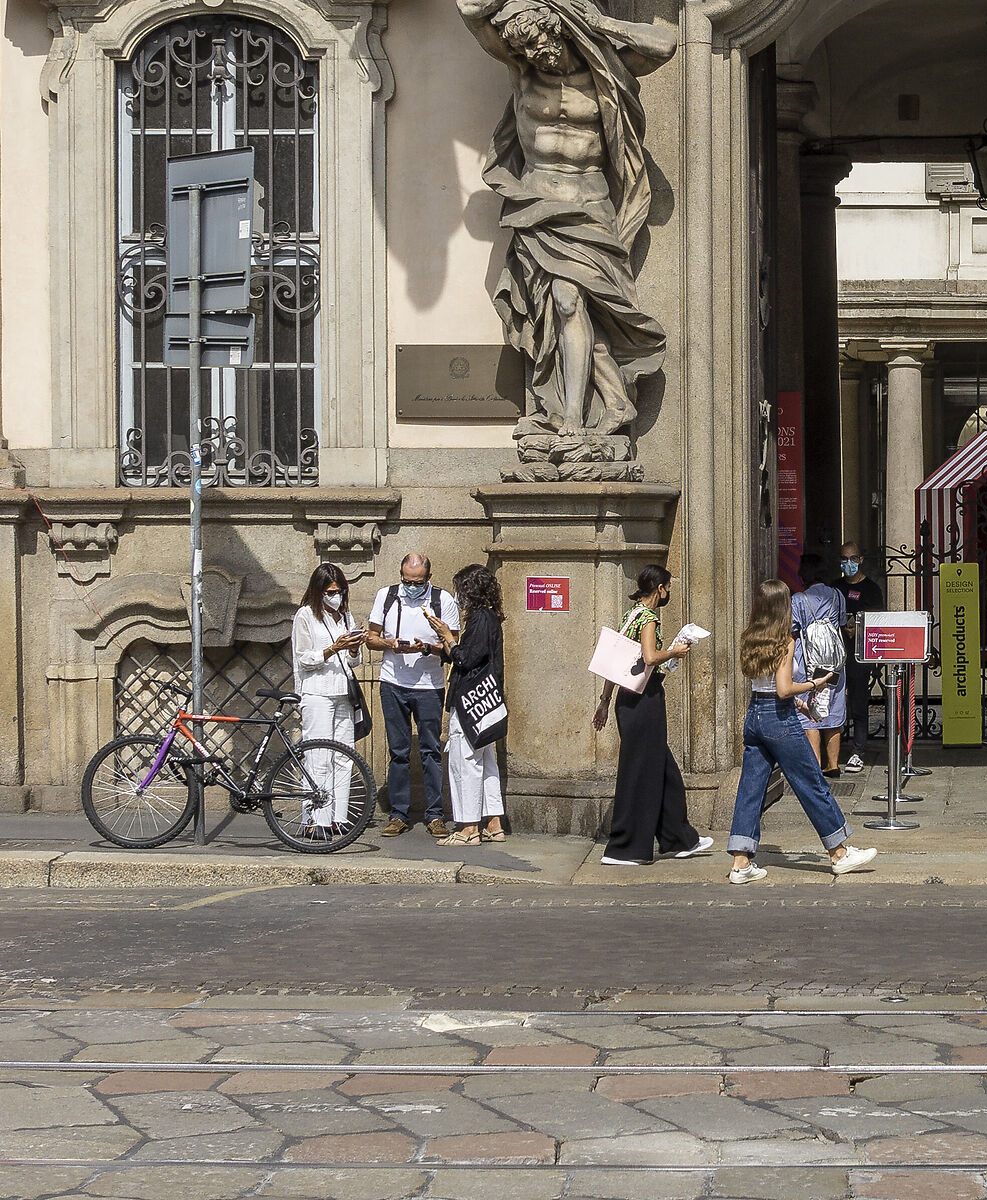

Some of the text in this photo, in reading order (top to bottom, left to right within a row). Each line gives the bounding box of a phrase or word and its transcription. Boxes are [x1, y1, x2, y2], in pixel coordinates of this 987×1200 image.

[952, 605, 969, 697] archiproducts
[461, 673, 497, 709] ARCHI
[466, 689, 502, 721] TONIC
